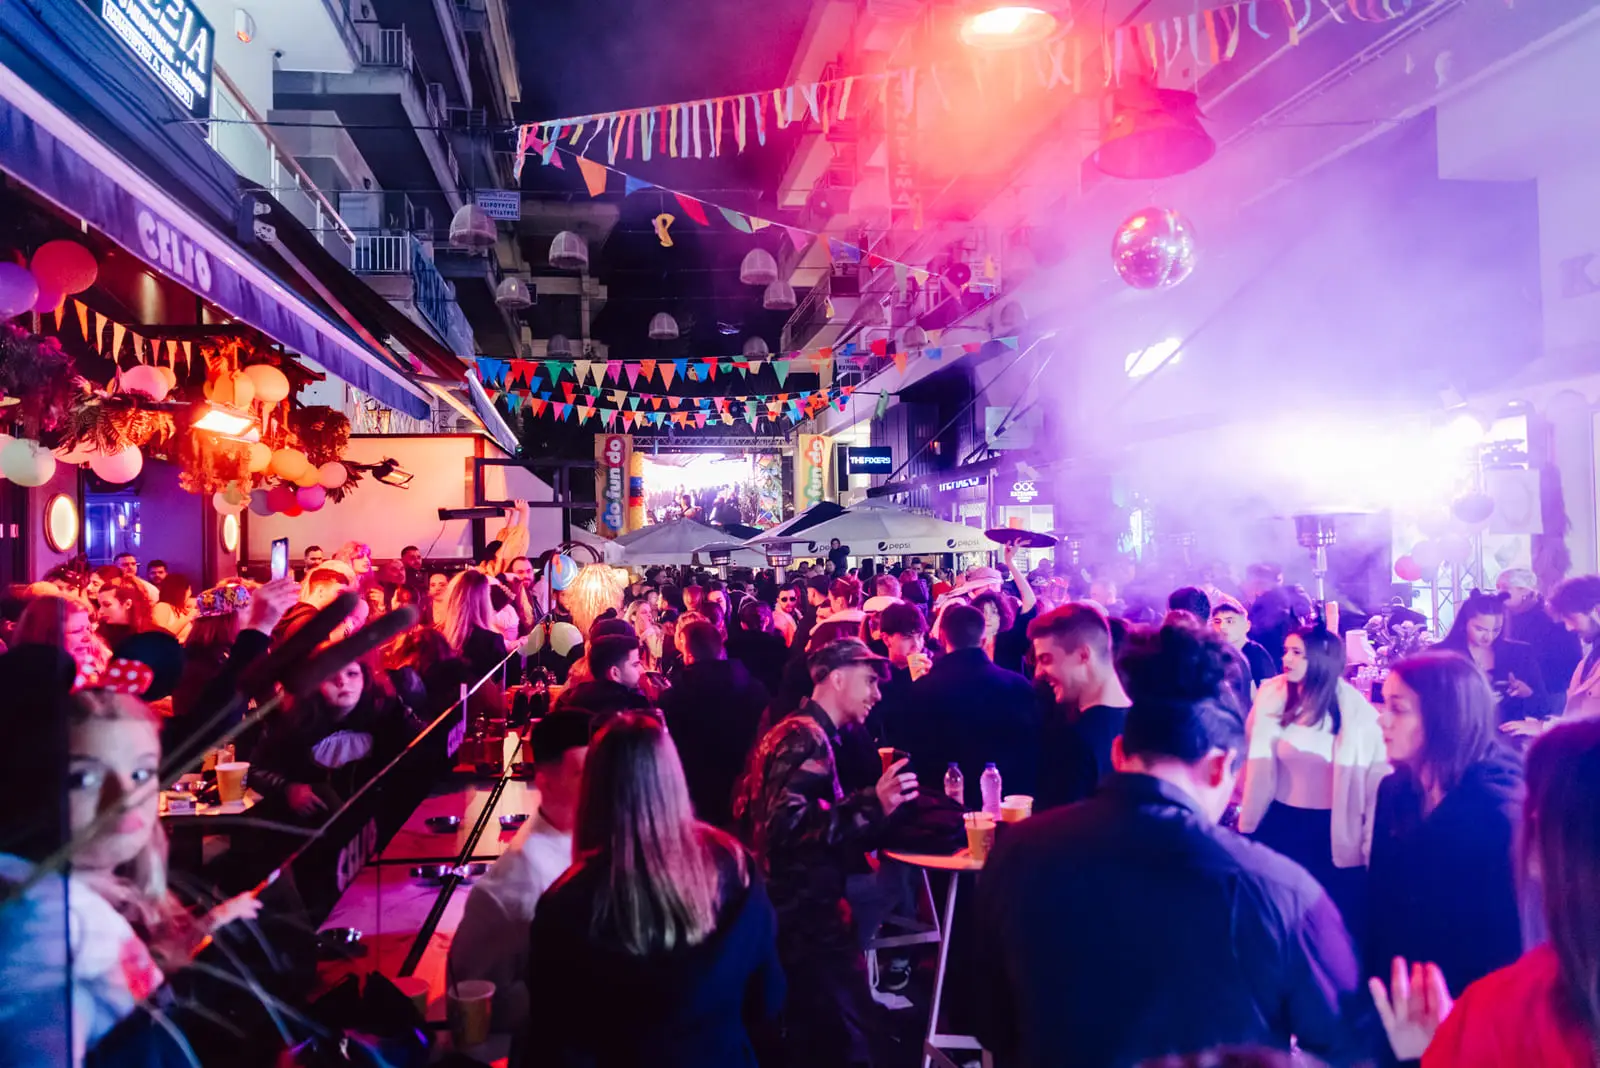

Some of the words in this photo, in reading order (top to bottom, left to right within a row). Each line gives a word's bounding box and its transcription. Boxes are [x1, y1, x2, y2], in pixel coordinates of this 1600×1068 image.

[850, 456, 864, 465] THE
[888, 542, 911, 550] pepsi
[957, 539, 980, 547] pepsi
